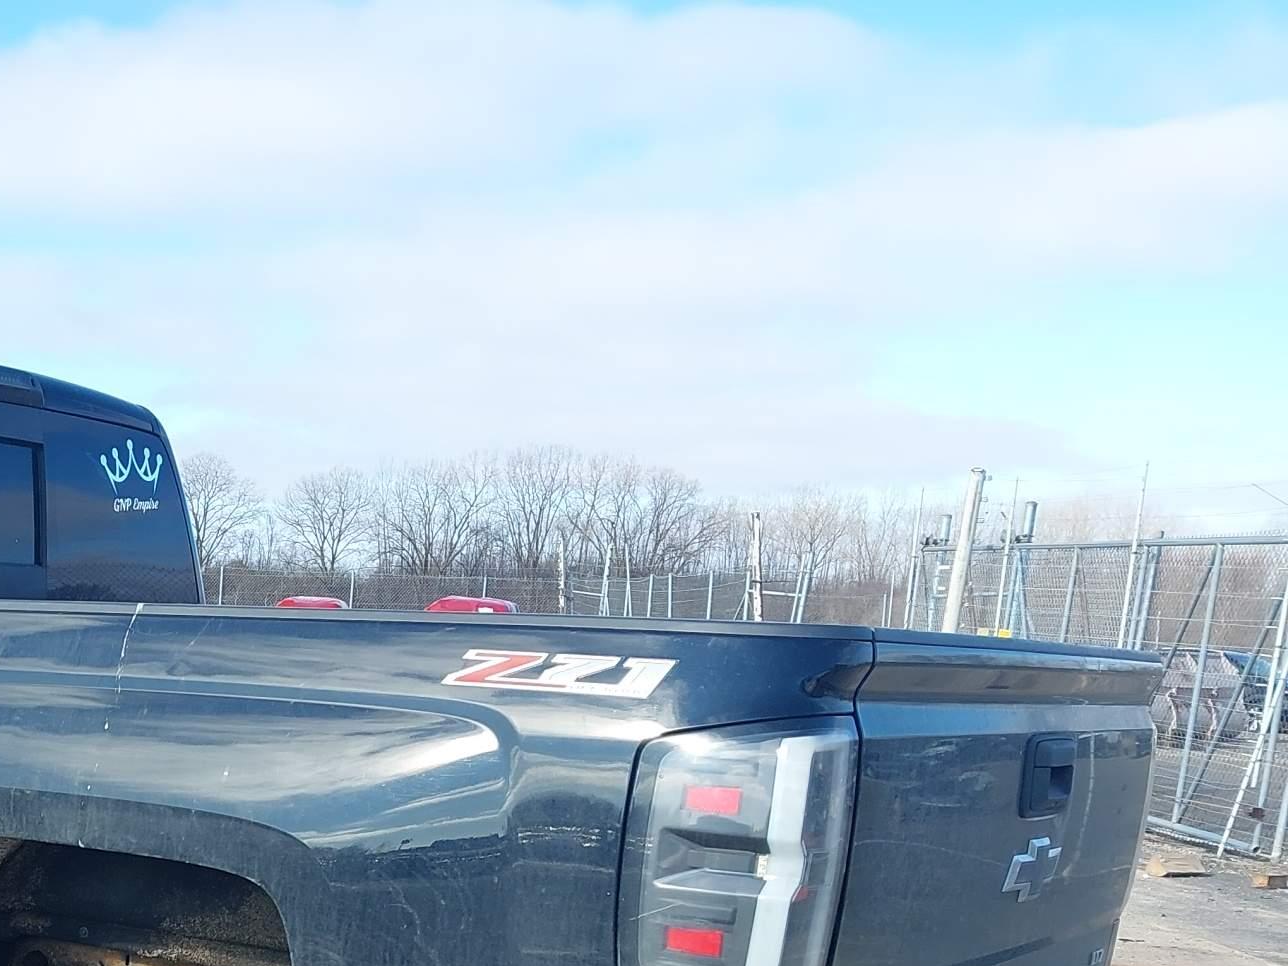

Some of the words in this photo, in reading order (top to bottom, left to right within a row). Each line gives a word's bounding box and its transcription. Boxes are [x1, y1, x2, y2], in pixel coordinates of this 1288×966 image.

[113, 497, 132, 513] GNP
[132, 497, 160, 515] Empire
[440, 648, 680, 700] Z71
